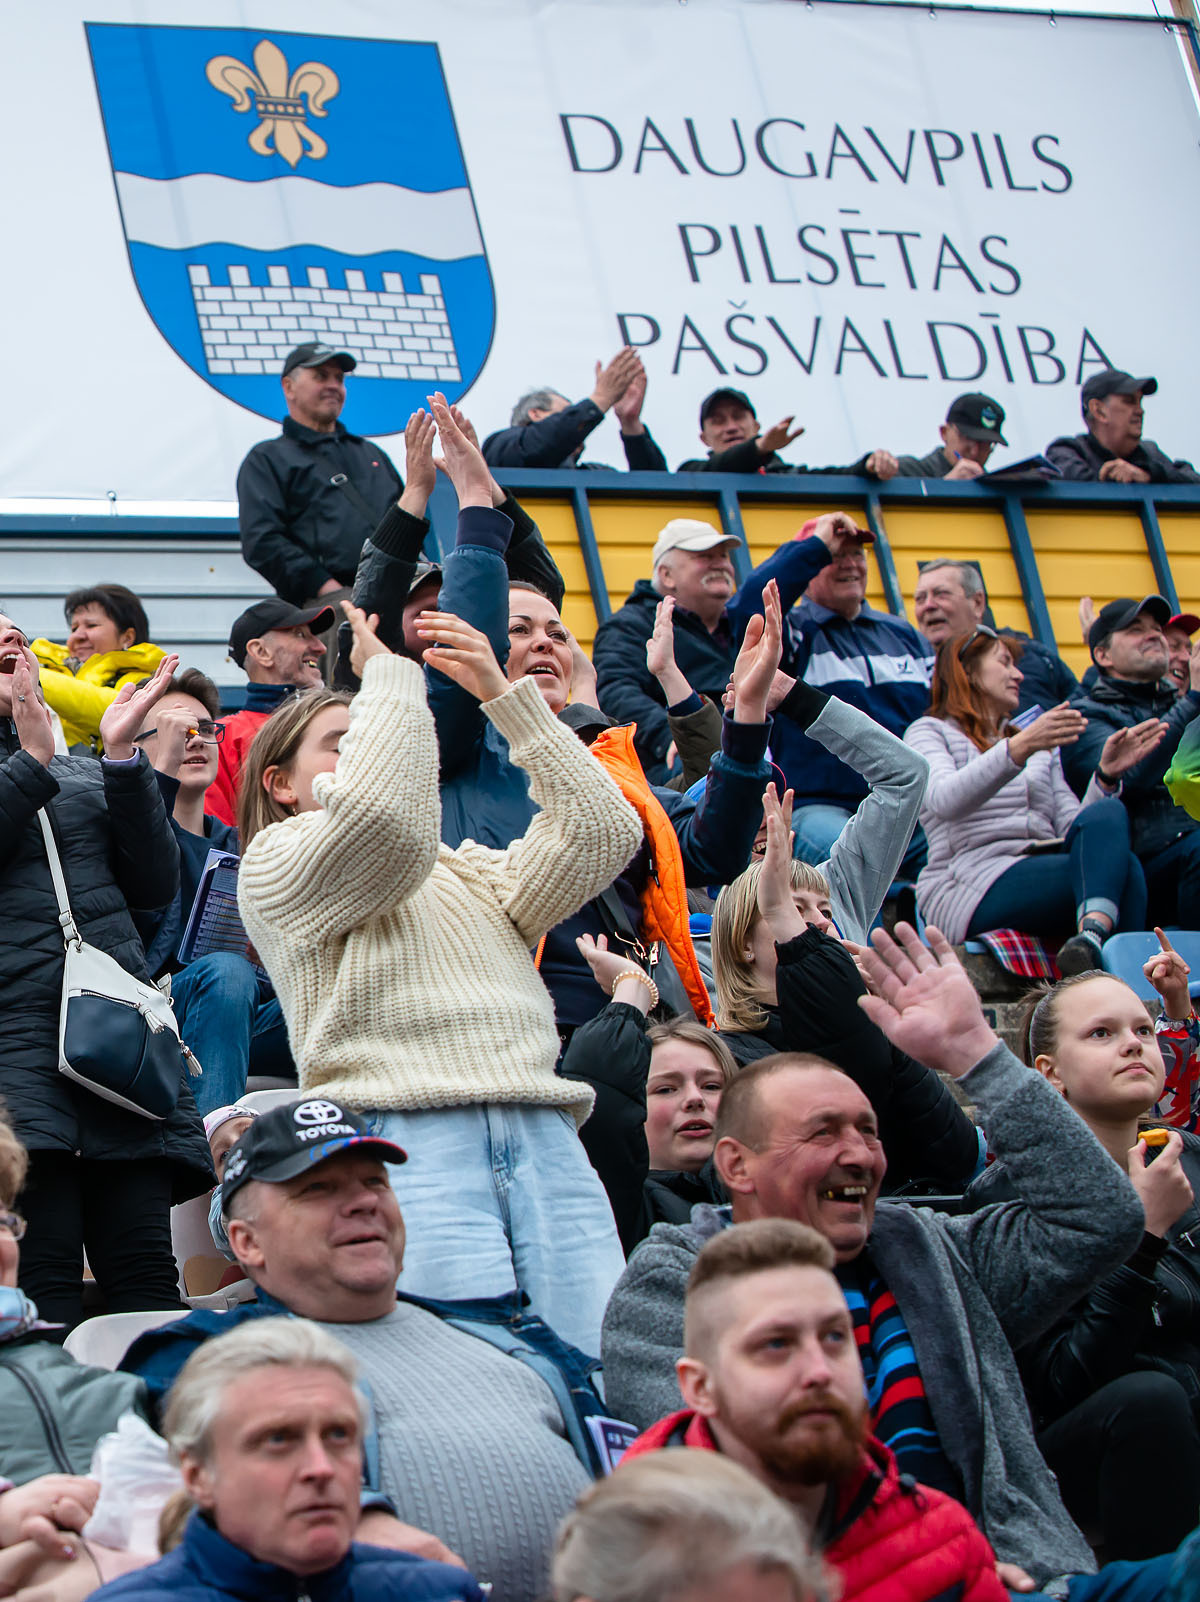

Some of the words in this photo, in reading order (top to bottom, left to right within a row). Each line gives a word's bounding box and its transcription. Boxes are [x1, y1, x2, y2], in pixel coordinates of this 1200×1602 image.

[559, 112, 1073, 194] DAUGAVPILS
[677, 209, 1021, 296] PILSĒTAS
[616, 299, 1112, 385] PAŠVALDĪBA
[295, 1123, 357, 1142] TOYOTA
